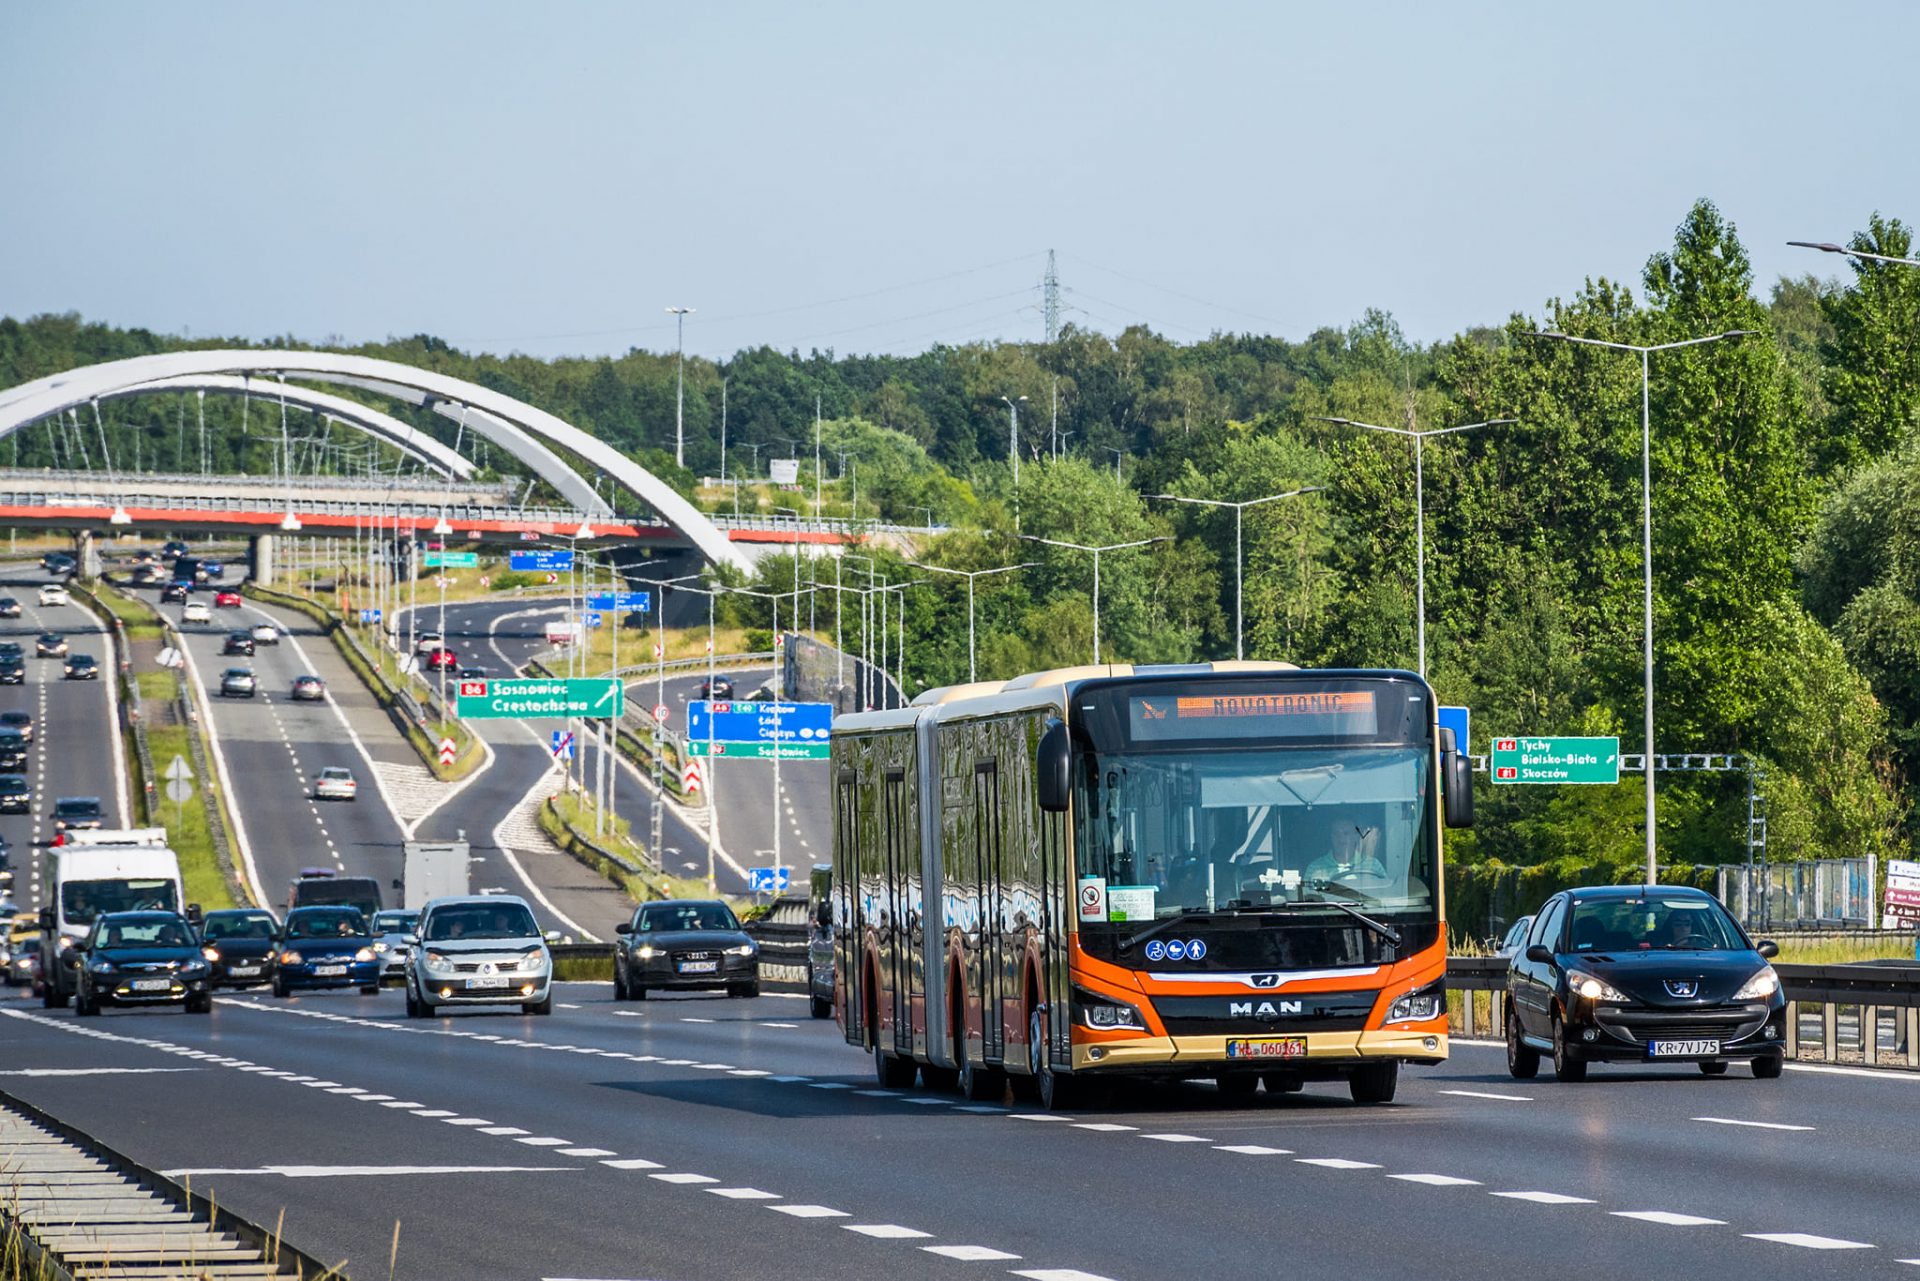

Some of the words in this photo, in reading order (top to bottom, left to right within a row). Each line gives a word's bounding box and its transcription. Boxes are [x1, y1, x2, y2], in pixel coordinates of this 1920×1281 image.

[464, 685, 482, 695] 86
[492, 683, 569, 695] Sosnowiec
[492, 700, 588, 713] Częstochowa
[1213, 694, 1343, 715] NOVATRONIC
[1501, 741, 1513, 750] 86
[1521, 740, 1551, 753] Tychy
[1521, 753, 1597, 765] Bielsko-Biała
[1502, 769, 1512, 778] 81
[1522, 767, 1568, 778] Skoczów
[1230, 1001, 1302, 1017] MAN
[1657, 1042, 1674, 1054] KR
[1678, 1041, 1717, 1054] 7VJ75
